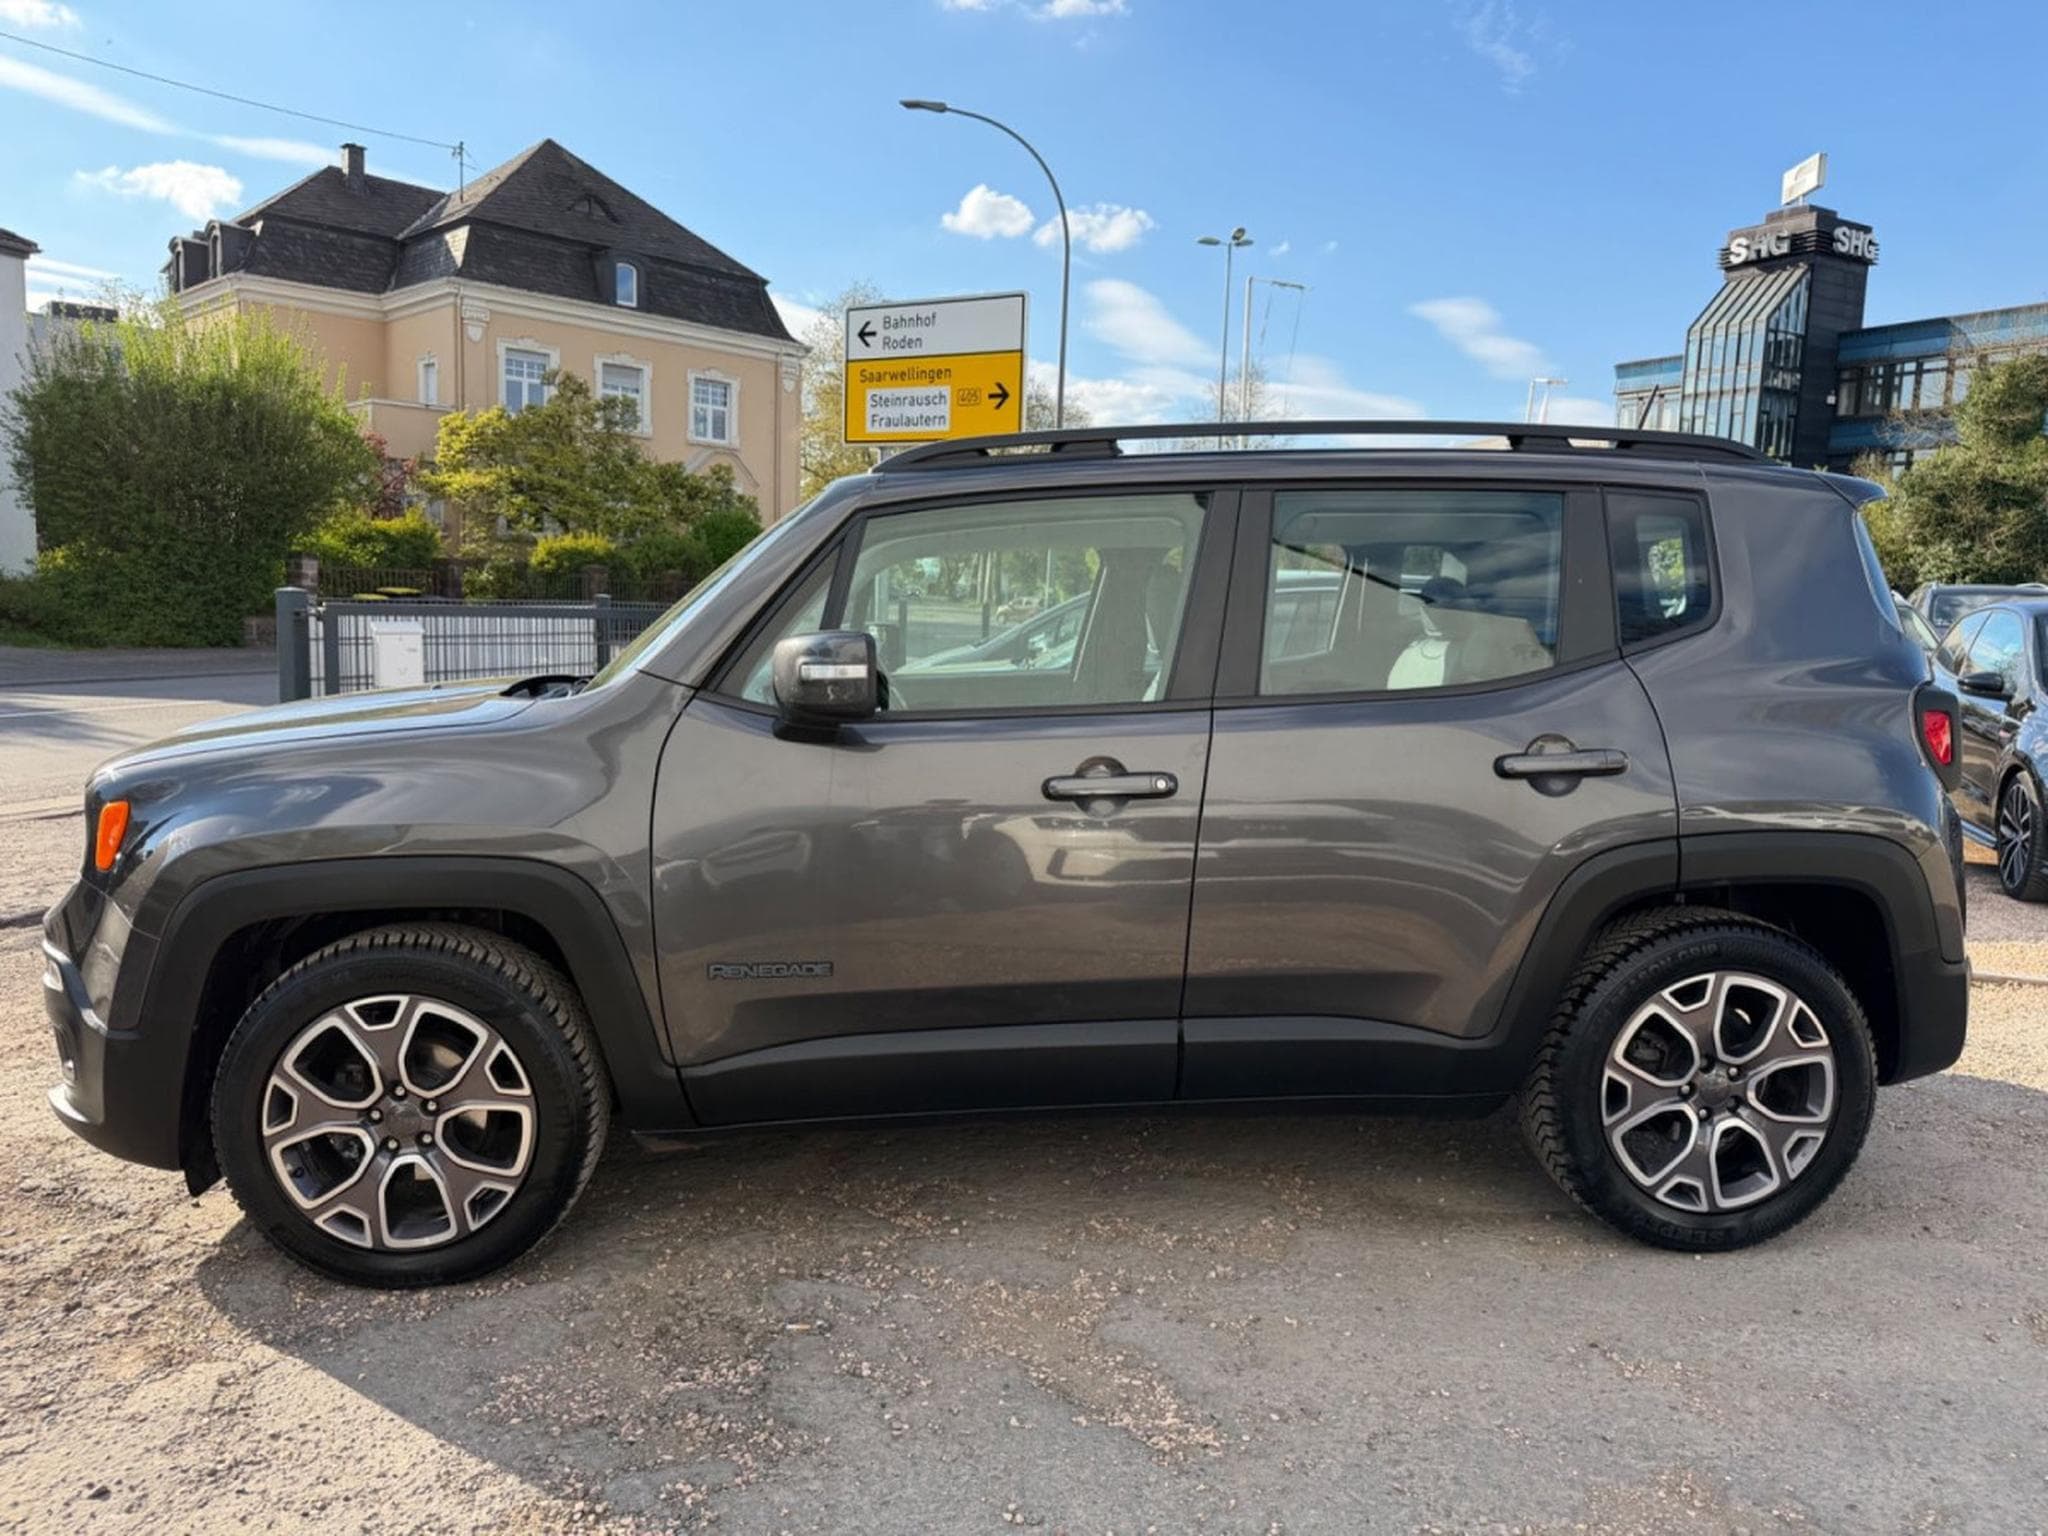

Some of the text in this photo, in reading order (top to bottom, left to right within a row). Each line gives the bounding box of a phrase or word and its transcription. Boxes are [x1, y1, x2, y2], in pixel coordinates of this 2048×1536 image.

[1729, 230, 1792, 264] SHG
[1833, 227, 1877, 260] SHG
[883, 312, 936, 330] Bahnhof
[883, 336, 922, 350] Roden
[859, 368, 952, 384] Saarwellingen
[870, 392, 947, 408] Steinrausch
[871, 414, 946, 428] Fraulautern
[709, 963, 832, 979] RENEGADE
